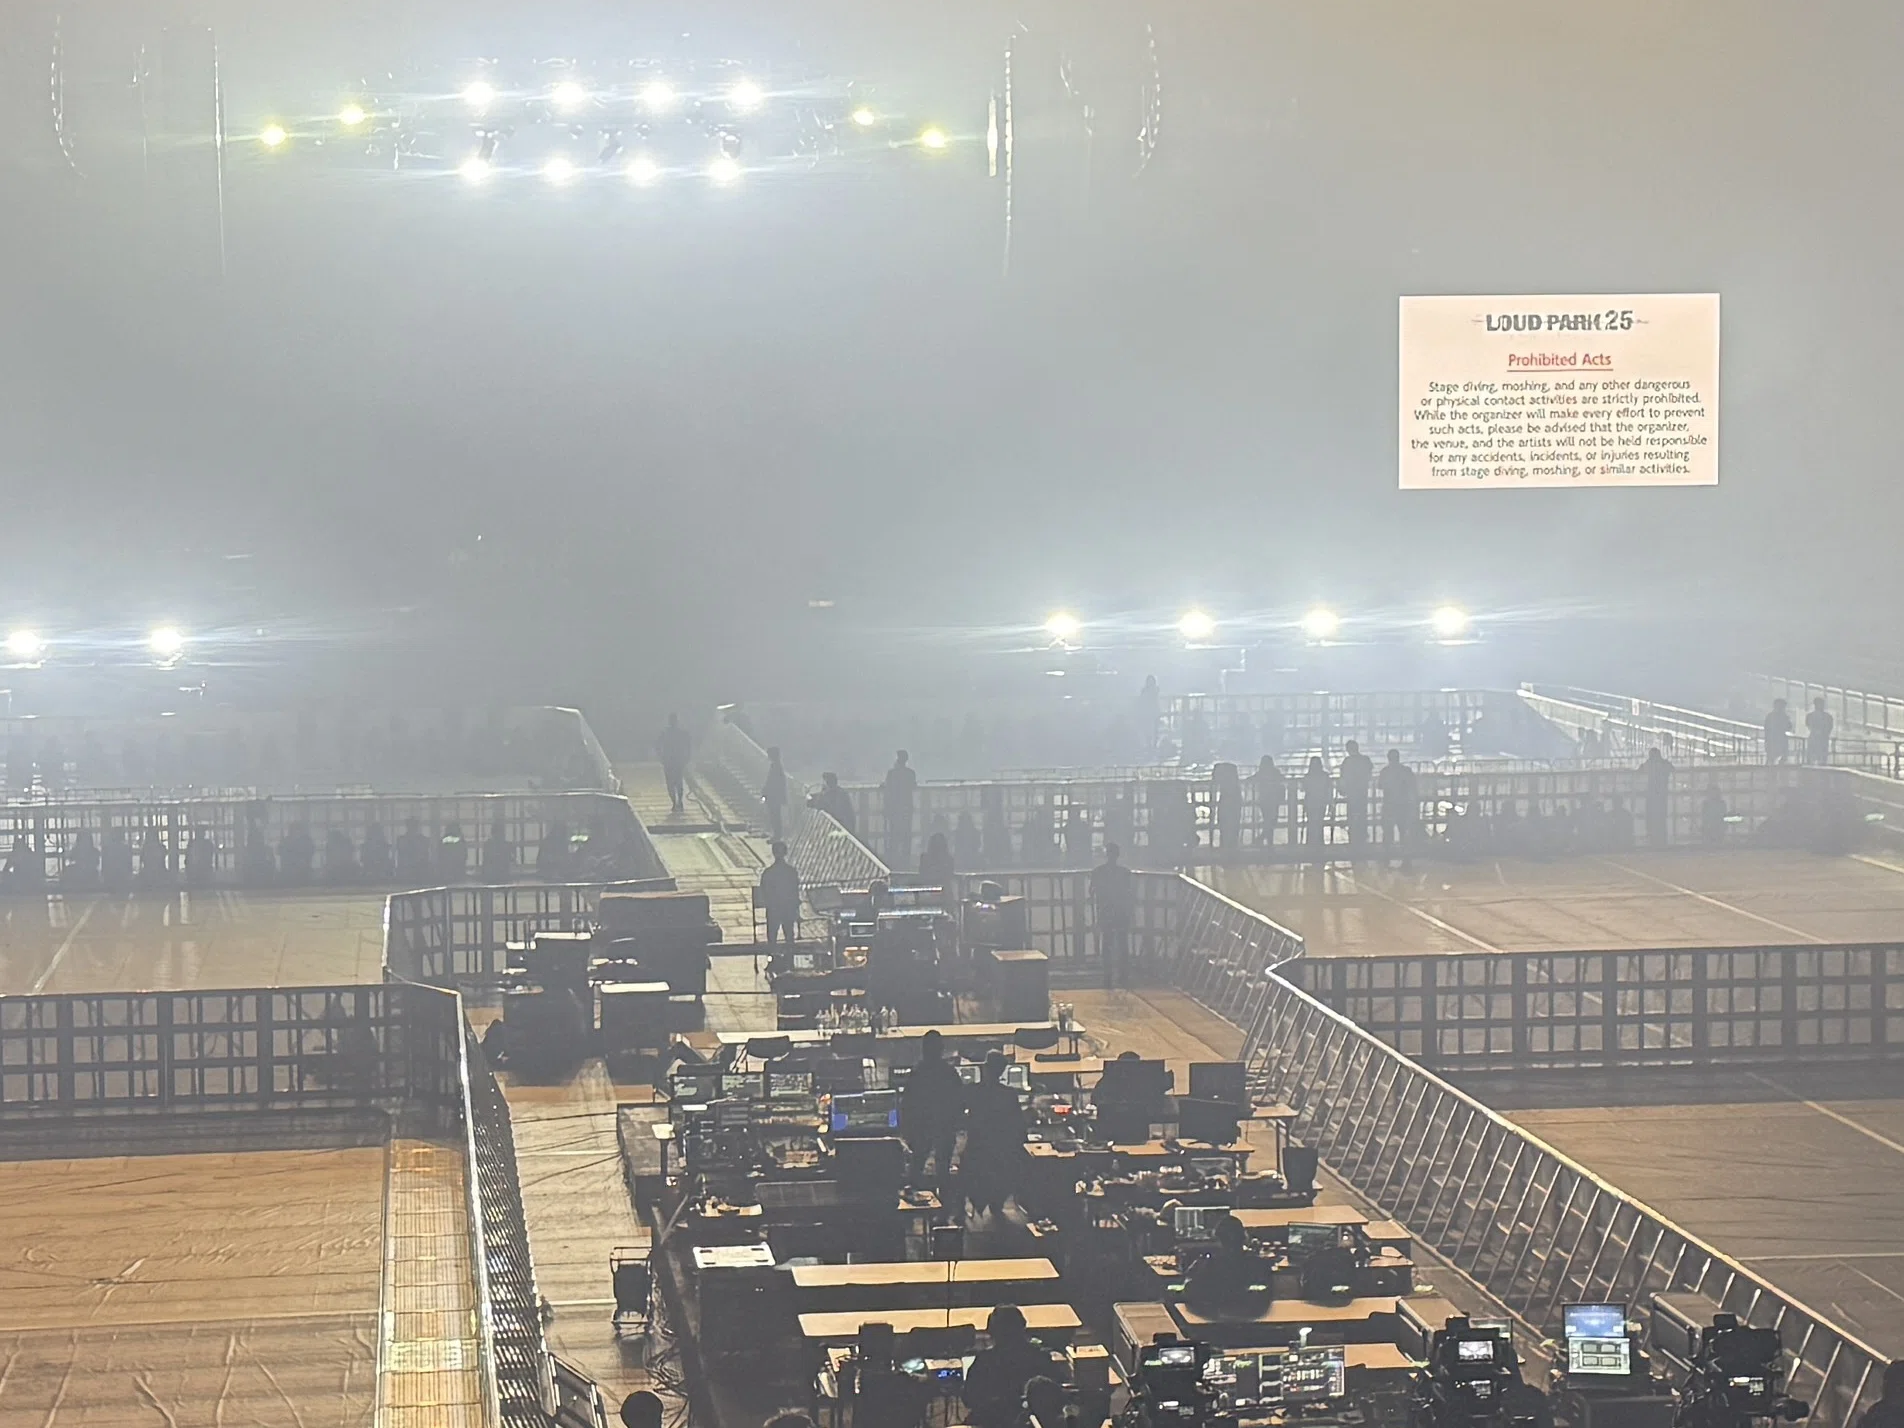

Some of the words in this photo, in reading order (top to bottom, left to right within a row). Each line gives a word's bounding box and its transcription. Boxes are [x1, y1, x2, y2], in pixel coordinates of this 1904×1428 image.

[1486, 314, 1542, 330] LOUD
[1544, 314, 1601, 330] PARK
[1605, 310, 1634, 330] 25
[1508, 353, 1576, 365] Prohibited
[1582, 353, 1611, 365] Acts
[1428, 381, 1458, 394] Stage
[1554, 380, 1574, 390] and
[1578, 382, 1598, 392] any
[1601, 380, 1631, 390] other
[1634, 379, 1690, 391] dangerous
[1436, 394, 1479, 408] physical
[1484, 395, 1525, 405] contact
[1528, 394, 1577, 404] activities
[1581, 396, 1598, 404] are
[1602, 393, 1638, 405] strictly
[1413, 408, 1445, 419] While
[1450, 410, 1468, 419] the
[1472, 410, 1522, 422] organizer
[1526, 408, 1545, 418] will
[1549, 408, 1578, 418] make
[1582, 410, 1612, 419] every
[1616, 407, 1644, 417] effort
[1648, 408, 1660, 417] to
[1664, 408, 1704, 419] prevent
[1429, 424, 1454, 434] such
[1488, 422, 1523, 435] please
[1527, 423, 1540, 432] be
[1544, 422, 1586, 432] advised
[1589, 422, 1611, 432] that
[1615, 422, 1633, 432] the
[1411, 439, 1428, 448] the
[1472, 438, 1492, 447] and
[1497, 438, 1514, 447] the
[1518, 437, 1551, 447] artists
[1555, 436, 1574, 446] will
[1578, 437, 1596, 446] not
[1600, 436, 1614, 446] be
[1618, 435, 1641, 445] held
[1646, 434, 1707, 446] responsible
[1428, 452, 1443, 462] for
[1448, 454, 1467, 464] any
[1585, 451, 1596, 460] or
[1600, 450, 1639, 462] injuries
[1643, 450, 1689, 461] resulting
[1431, 466, 1456, 476] from
[1460, 464, 1489, 478] stage
[1584, 466, 1596, 474] or
[1599, 464, 1635, 474] similar
